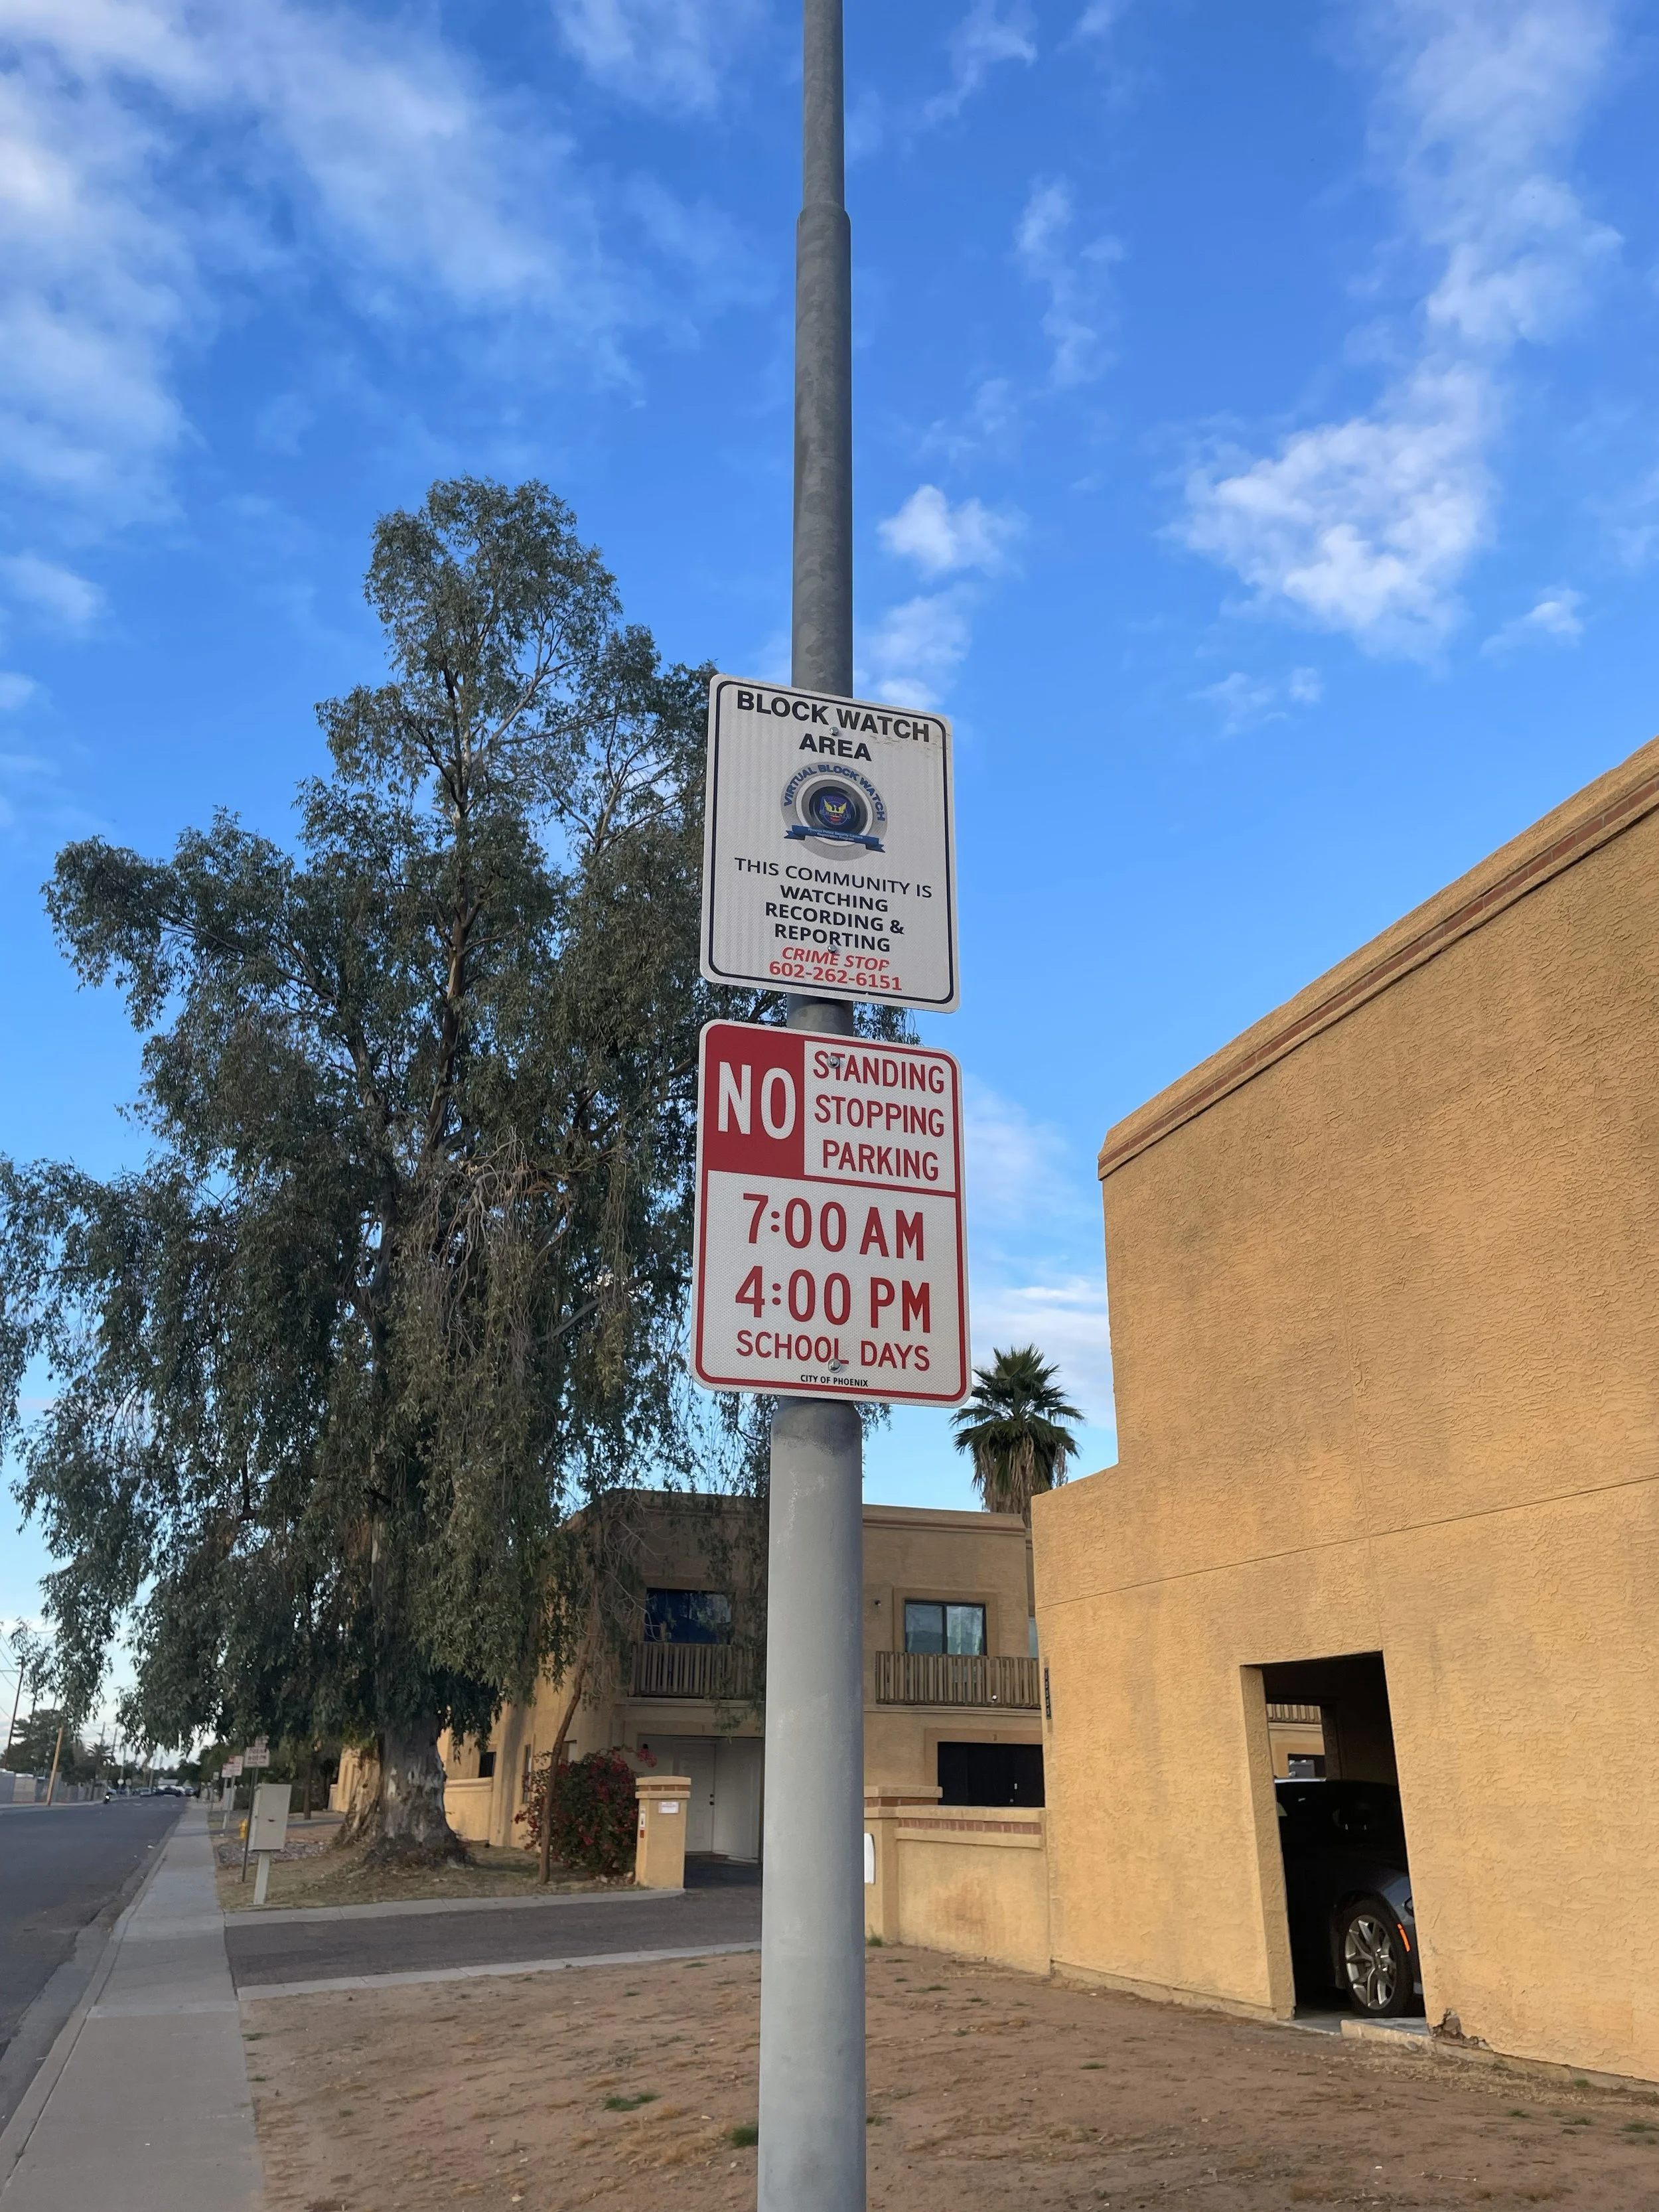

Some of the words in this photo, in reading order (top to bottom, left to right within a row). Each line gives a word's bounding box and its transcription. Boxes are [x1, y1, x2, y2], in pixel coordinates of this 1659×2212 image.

[737, 690, 829, 725] BLOCK
[837, 709, 929, 742] WATCH
[799, 733, 872, 761] AREA
[784, 767, 817, 806] VIRTUAL
[818, 765, 859, 781] BLOCK
[859, 777, 885, 821] WATCH
[735, 857, 779, 875] THIS
[786, 865, 910, 897] COMMUNITY
[917, 884, 932, 898] IS
[766, 903, 883, 931] RECORDING
[890, 920, 904, 934] &
[780, 885, 888, 912] WATCHING
[775, 924, 891, 952] REPORTING
[770, 961, 902, 990] 602-262-6151
[782, 947, 839, 966] CRIME
[845, 955, 890, 972] STOP
[814, 1051, 944, 1094] STANDING
[718, 1061, 796, 1140] NO
[815, 1094, 944, 1137] STOPPING
[824, 1140, 938, 1181] PARKING
[743, 1193, 847, 1252] 7:00
[859, 1207, 924, 1261] AM
[735, 1266, 851, 1325] 4:00
[871, 1278, 930, 1333] PM
[737, 1330, 849, 1365] SCHOOL
[861, 1341, 930, 1371] DAYS
[800, 1374, 819, 1384] CITY
[833, 1377, 868, 1387] PHOENIX
